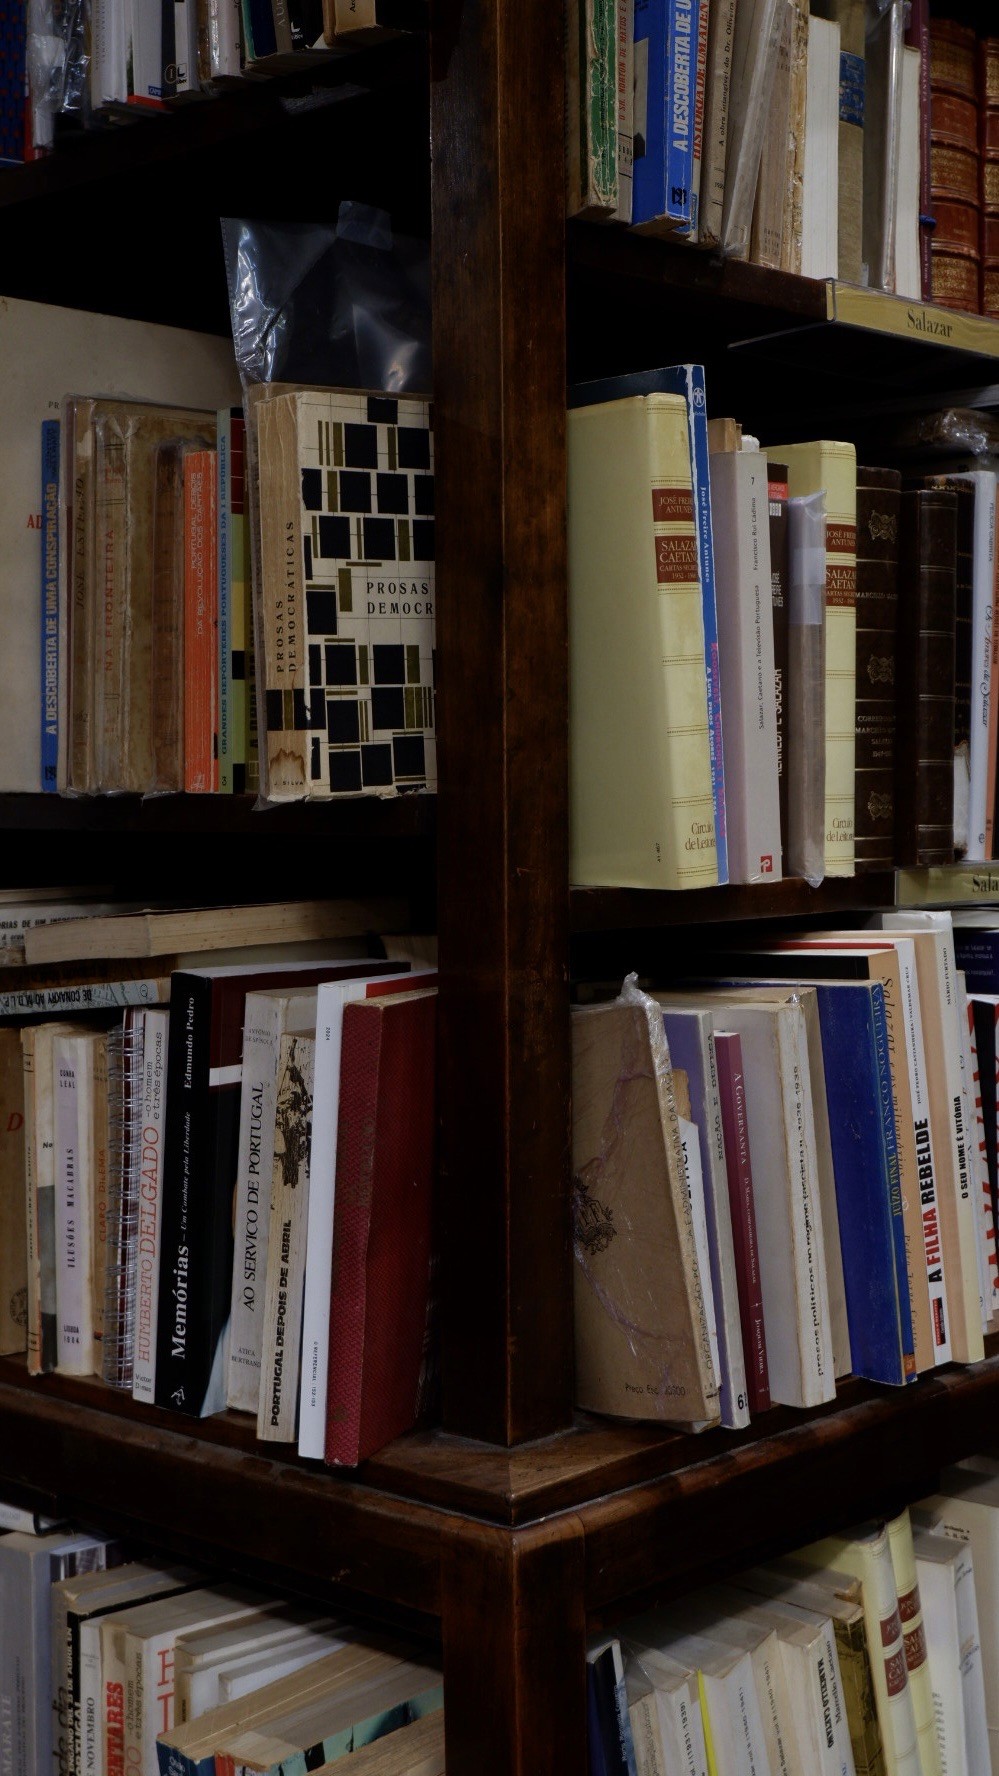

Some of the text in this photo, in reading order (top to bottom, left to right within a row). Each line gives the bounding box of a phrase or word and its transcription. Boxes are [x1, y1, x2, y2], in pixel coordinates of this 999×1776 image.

[672, 12, 691, 152] A DESCOBERTA DE
[907, 310, 953, 338] Salazar
[221, 512, 227, 529] DA
[659, 495, 678, 506] JOSÉ
[44, 482, 57, 579] CONSPIRAÇÃO
[702, 510, 710, 540] Freire
[703, 542, 711, 583] Antunes
[45, 581, 57, 615] UMA
[105, 529, 113, 672] NA FRONTEIRA
[285, 520, 297, 673] DEMOCRÁTICAS
[366, 581, 429, 595] PROSAS
[367, 601, 434, 615] DEMOCR
[753, 584, 761, 624] Portuguesa
[45, 617, 57, 635] DE
[275, 599, 285, 673] PROSAS
[754, 626, 762, 658] Televisão
[45, 637, 57, 721] DESCOBERTA
[45, 724, 57, 735] A
[684, 837, 695, 850] de
[972, 872, 999, 893] Sala
[0, 921, 18, 929] RIAS
[22, 920, 31, 928] DE
[48, 990, 80, 1004] CONAKRY
[82, 989, 92, 1001] DE
[152, 1032, 163, 1077] épocas
[183, 997, 195, 1089] Edmundo Pedro
[707, 1033, 718, 1088] DEFESA
[144, 1061, 154, 1103] homem
[151, 1080, 161, 1110] três
[872, 986, 902, 1218] JUÍZO FINAL FRANCO NOGUEIRA
[734, 1071, 747, 1172] A GOVERNANTA
[953, 1097, 964, 1136] VITÓRIA
[714, 1115, 725, 1161] NAÇÃO
[958, 1145, 967, 1172] NOME
[138, 1126, 159, 1258] DELGADO
[243, 1081, 263, 1312] AO SERVIÇO DE PORTUGAL
[914, 1119, 943, 1286] A FILHA REBELDE
[960, 1173, 969, 1192] SEU
[65, 1149, 76, 1269] ILUSÕES MACABRAS
[803, 1203, 813, 1247] regime
[171, 1112, 191, 1360] Memórias Um Combate pela Liberdade
[138, 1259, 153, 1364] HUMBERTO
[270, 1219, 292, 1427] PORTUGAL DEPOIS DE ABRIL
[694, 1282, 713, 1371] ORGANIZAÇÃO
[737, 1394, 744, 1409] 6
[825, 1640, 842, 1724] Marcello Caetano
[86, 1697, 96, 1769] NOVEMBRO
[817, 1708, 834, 1749] MARCELLO CAETANO
